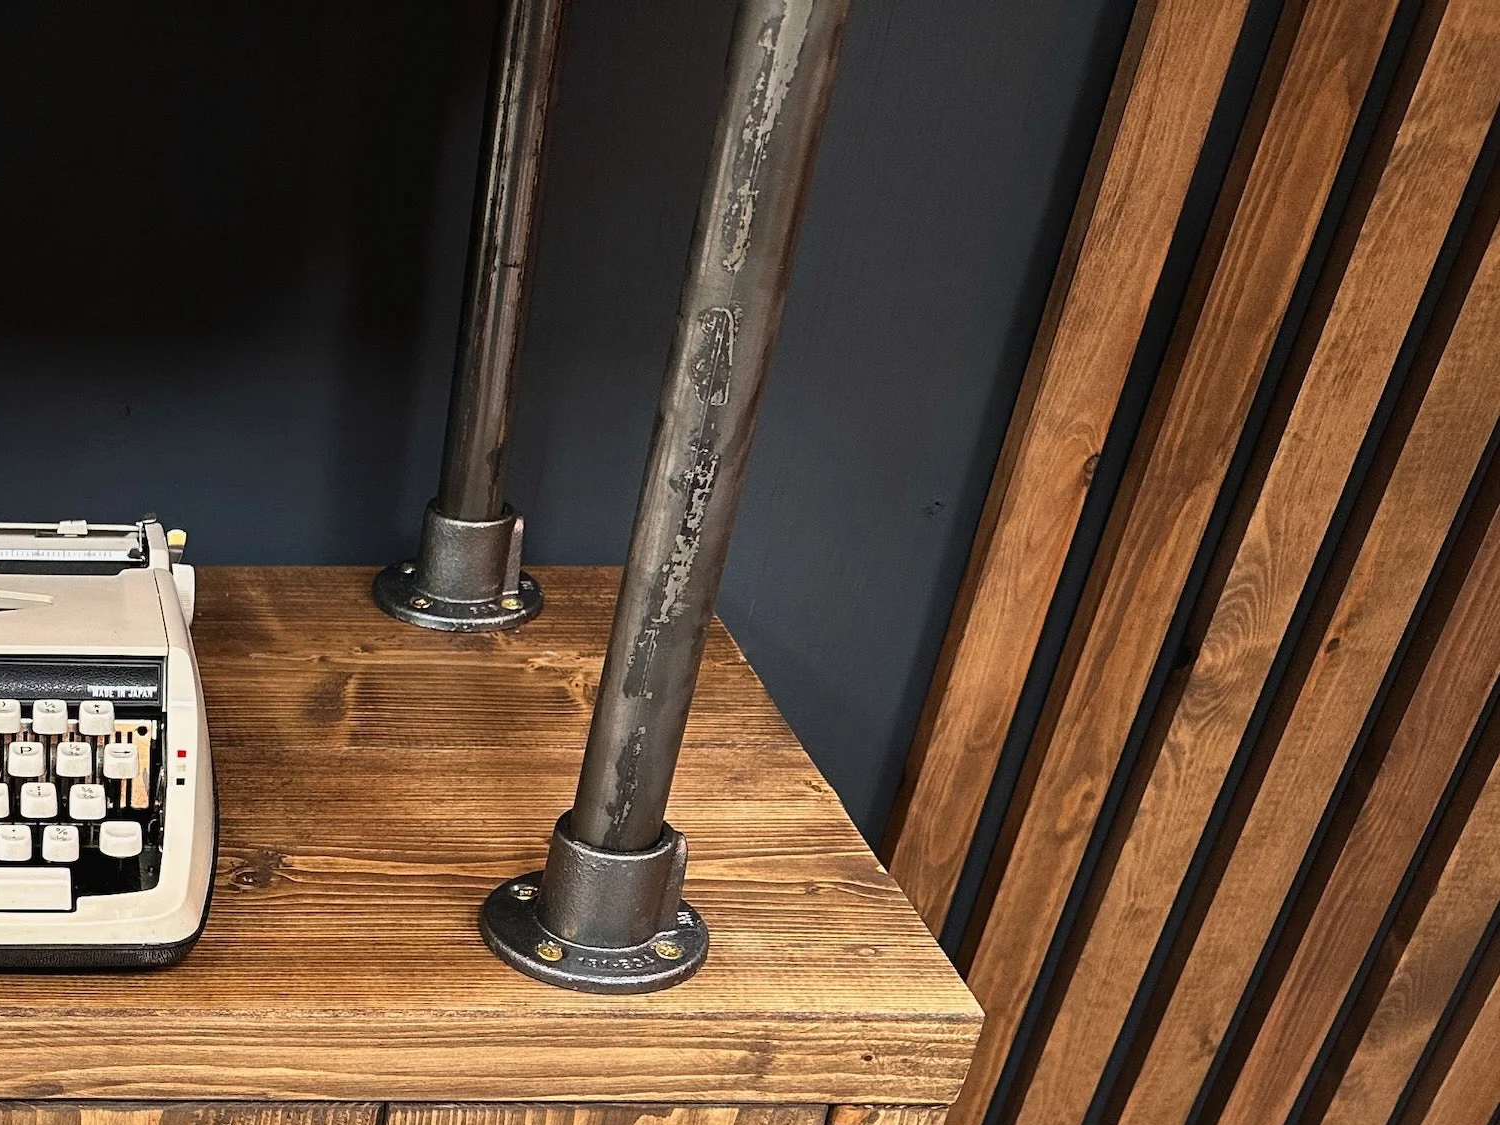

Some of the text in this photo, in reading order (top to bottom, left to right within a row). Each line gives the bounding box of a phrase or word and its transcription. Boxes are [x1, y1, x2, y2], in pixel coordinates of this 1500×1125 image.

[92, 686, 153, 697] MADE IN JAPAN
